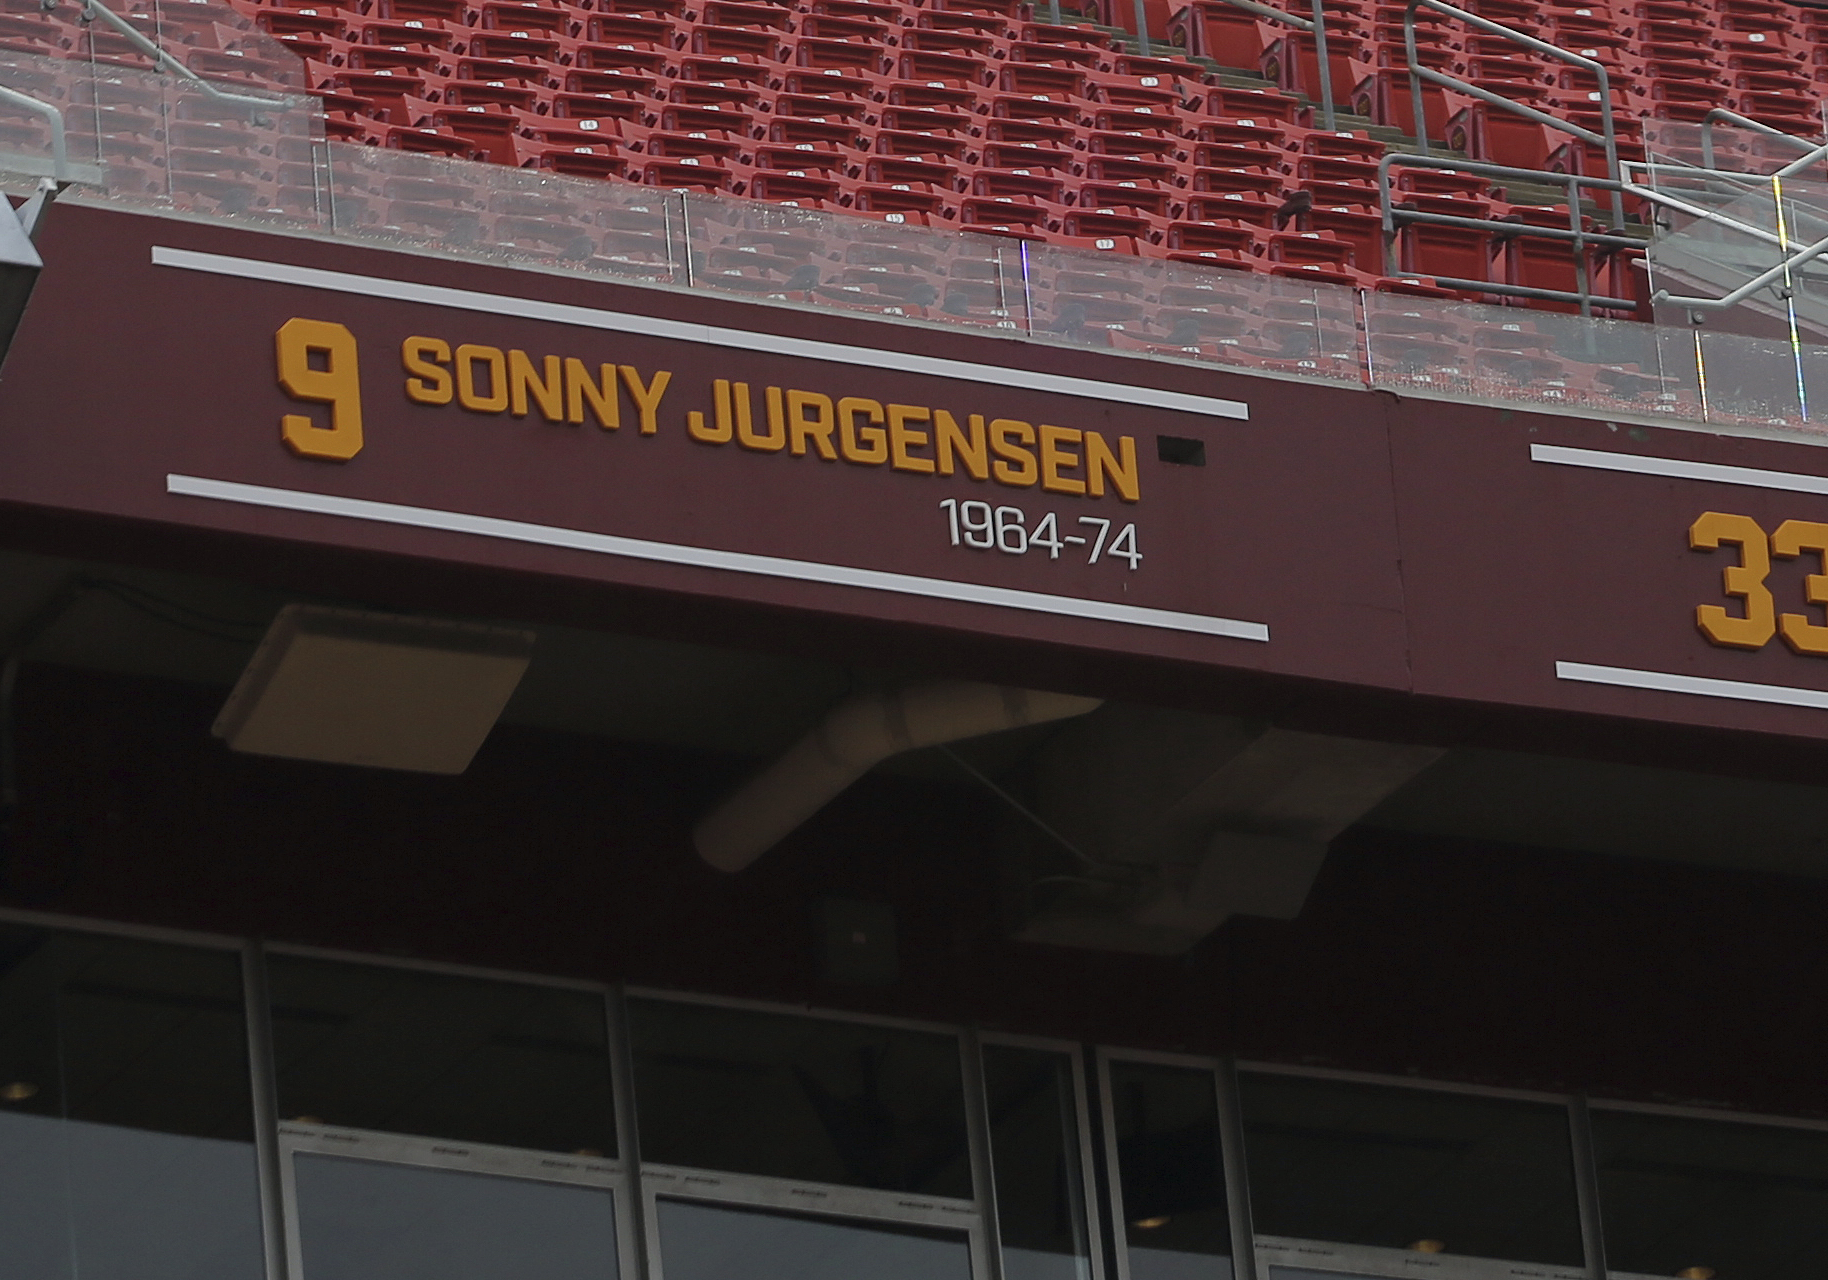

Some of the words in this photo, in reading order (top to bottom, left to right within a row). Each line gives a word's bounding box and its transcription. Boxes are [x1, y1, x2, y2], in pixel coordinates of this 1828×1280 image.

[274, 317, 366, 461] 9
[401, 334, 674, 435] SONNY
[686, 377, 1143, 502] JURGENSEN
[938, 497, 1144, 571] 1964-74
